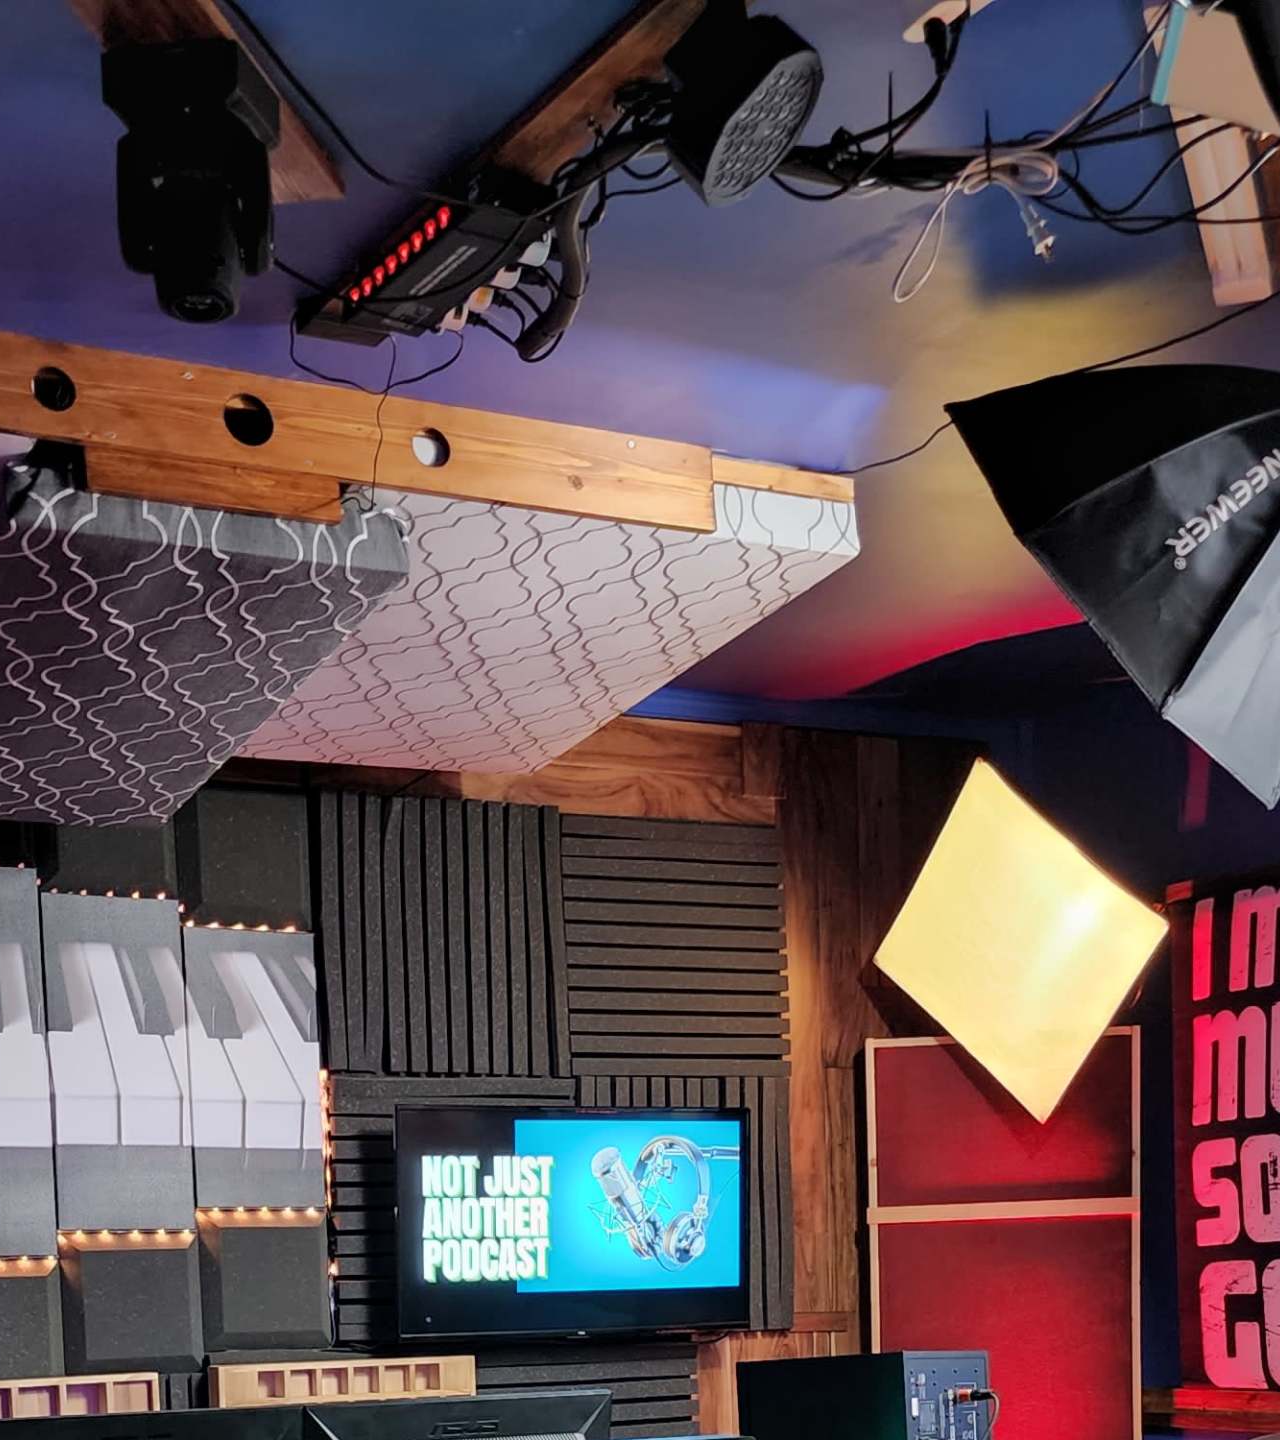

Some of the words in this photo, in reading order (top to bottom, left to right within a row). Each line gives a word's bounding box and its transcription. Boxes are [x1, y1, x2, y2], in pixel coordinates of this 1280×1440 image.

[1192, 898, 1214, 1000] I
[422, 1155, 480, 1198] NOT
[483, 1155, 554, 1198] JUST
[422, 1197, 550, 1239] ANOTHER
[422, 1237, 551, 1283] PODCAST
